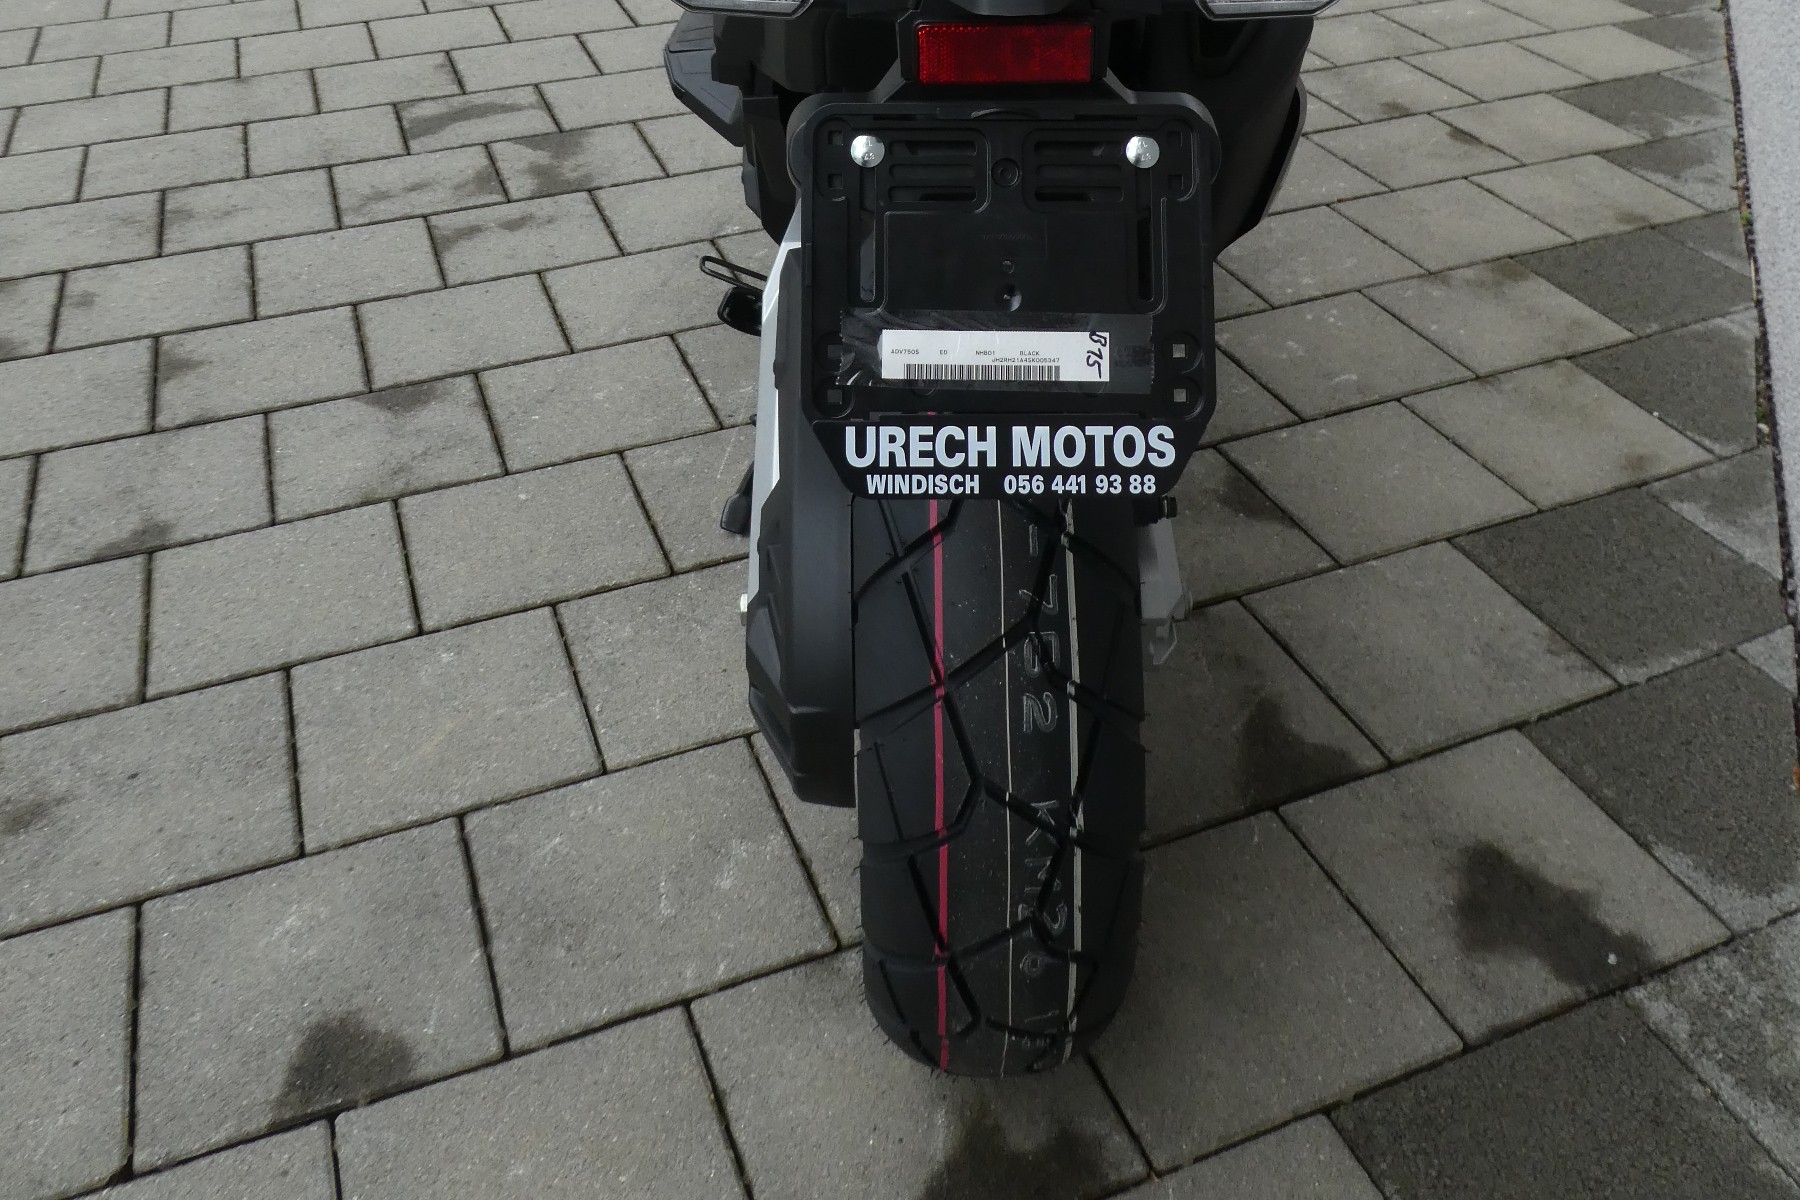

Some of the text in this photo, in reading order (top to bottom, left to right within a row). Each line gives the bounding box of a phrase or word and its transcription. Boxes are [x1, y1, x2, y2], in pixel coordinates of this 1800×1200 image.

[845, 425, 1176, 467] URECH MOTOS
[866, 475, 1156, 494] WINDISCH 056 441 93 88
